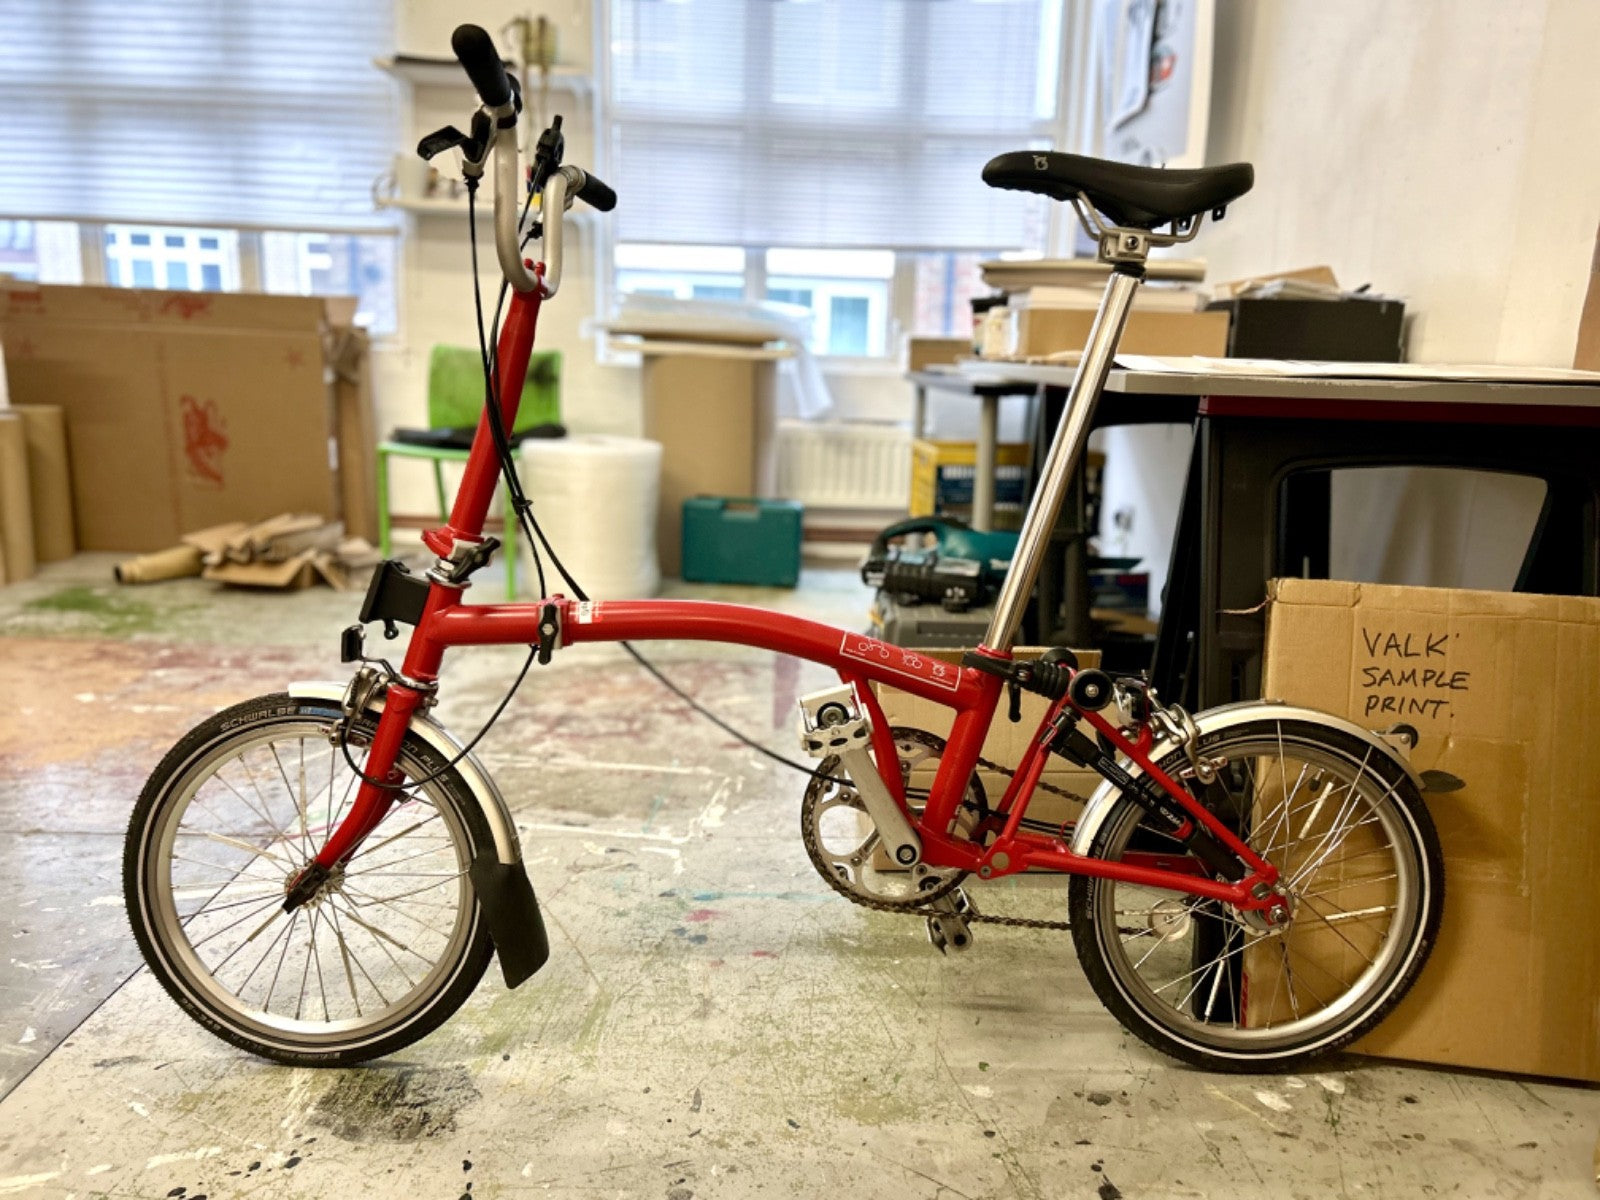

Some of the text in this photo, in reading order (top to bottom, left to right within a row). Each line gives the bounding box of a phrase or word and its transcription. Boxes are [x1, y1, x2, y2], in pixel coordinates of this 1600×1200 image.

[1361, 666, 1471, 690] SAMPLE
[220, 706, 297, 732] SCHWALBE
[1364, 694, 1455, 719] PRINT.
